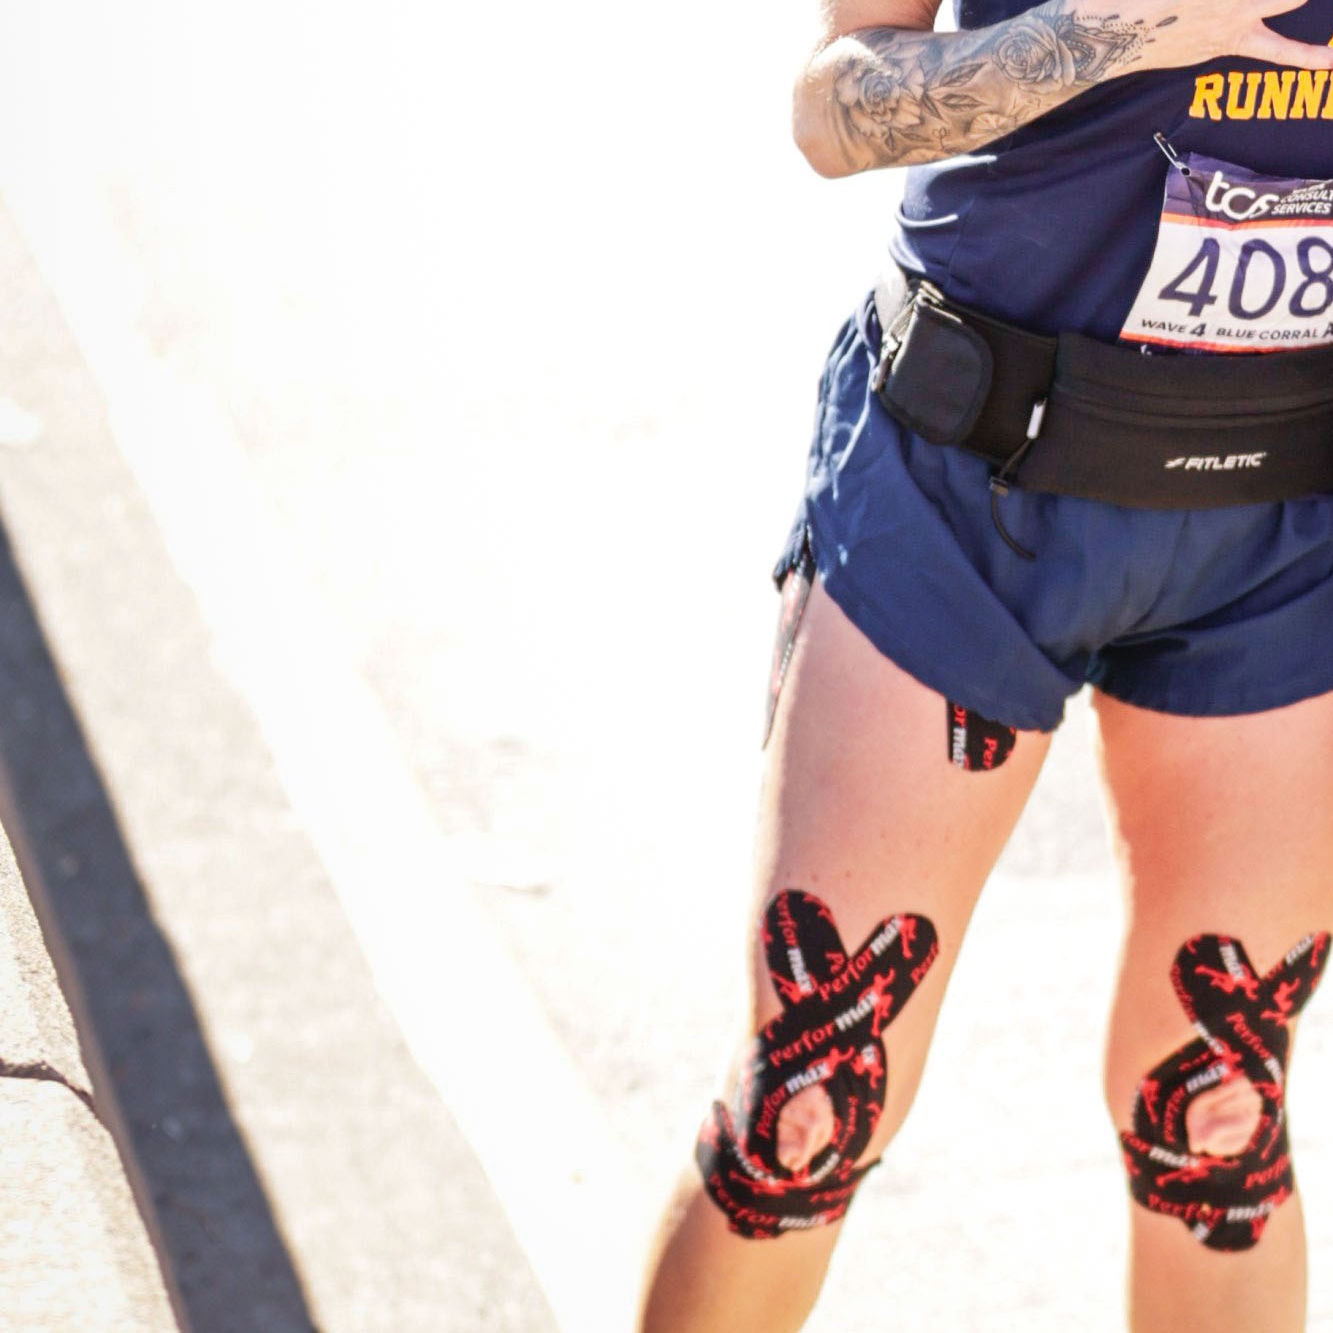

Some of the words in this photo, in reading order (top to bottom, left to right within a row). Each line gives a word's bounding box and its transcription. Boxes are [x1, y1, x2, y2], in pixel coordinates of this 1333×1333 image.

[1271, 202, 1332, 215] SERVICES
[1141, 319, 1186, 334] WAVE
[1189, 322, 1207, 338] 4
[1215, 326, 1255, 339] BLUE
[1259, 327, 1319, 341] CORRAL
[1184, 453, 1263, 471] FITLETIC
